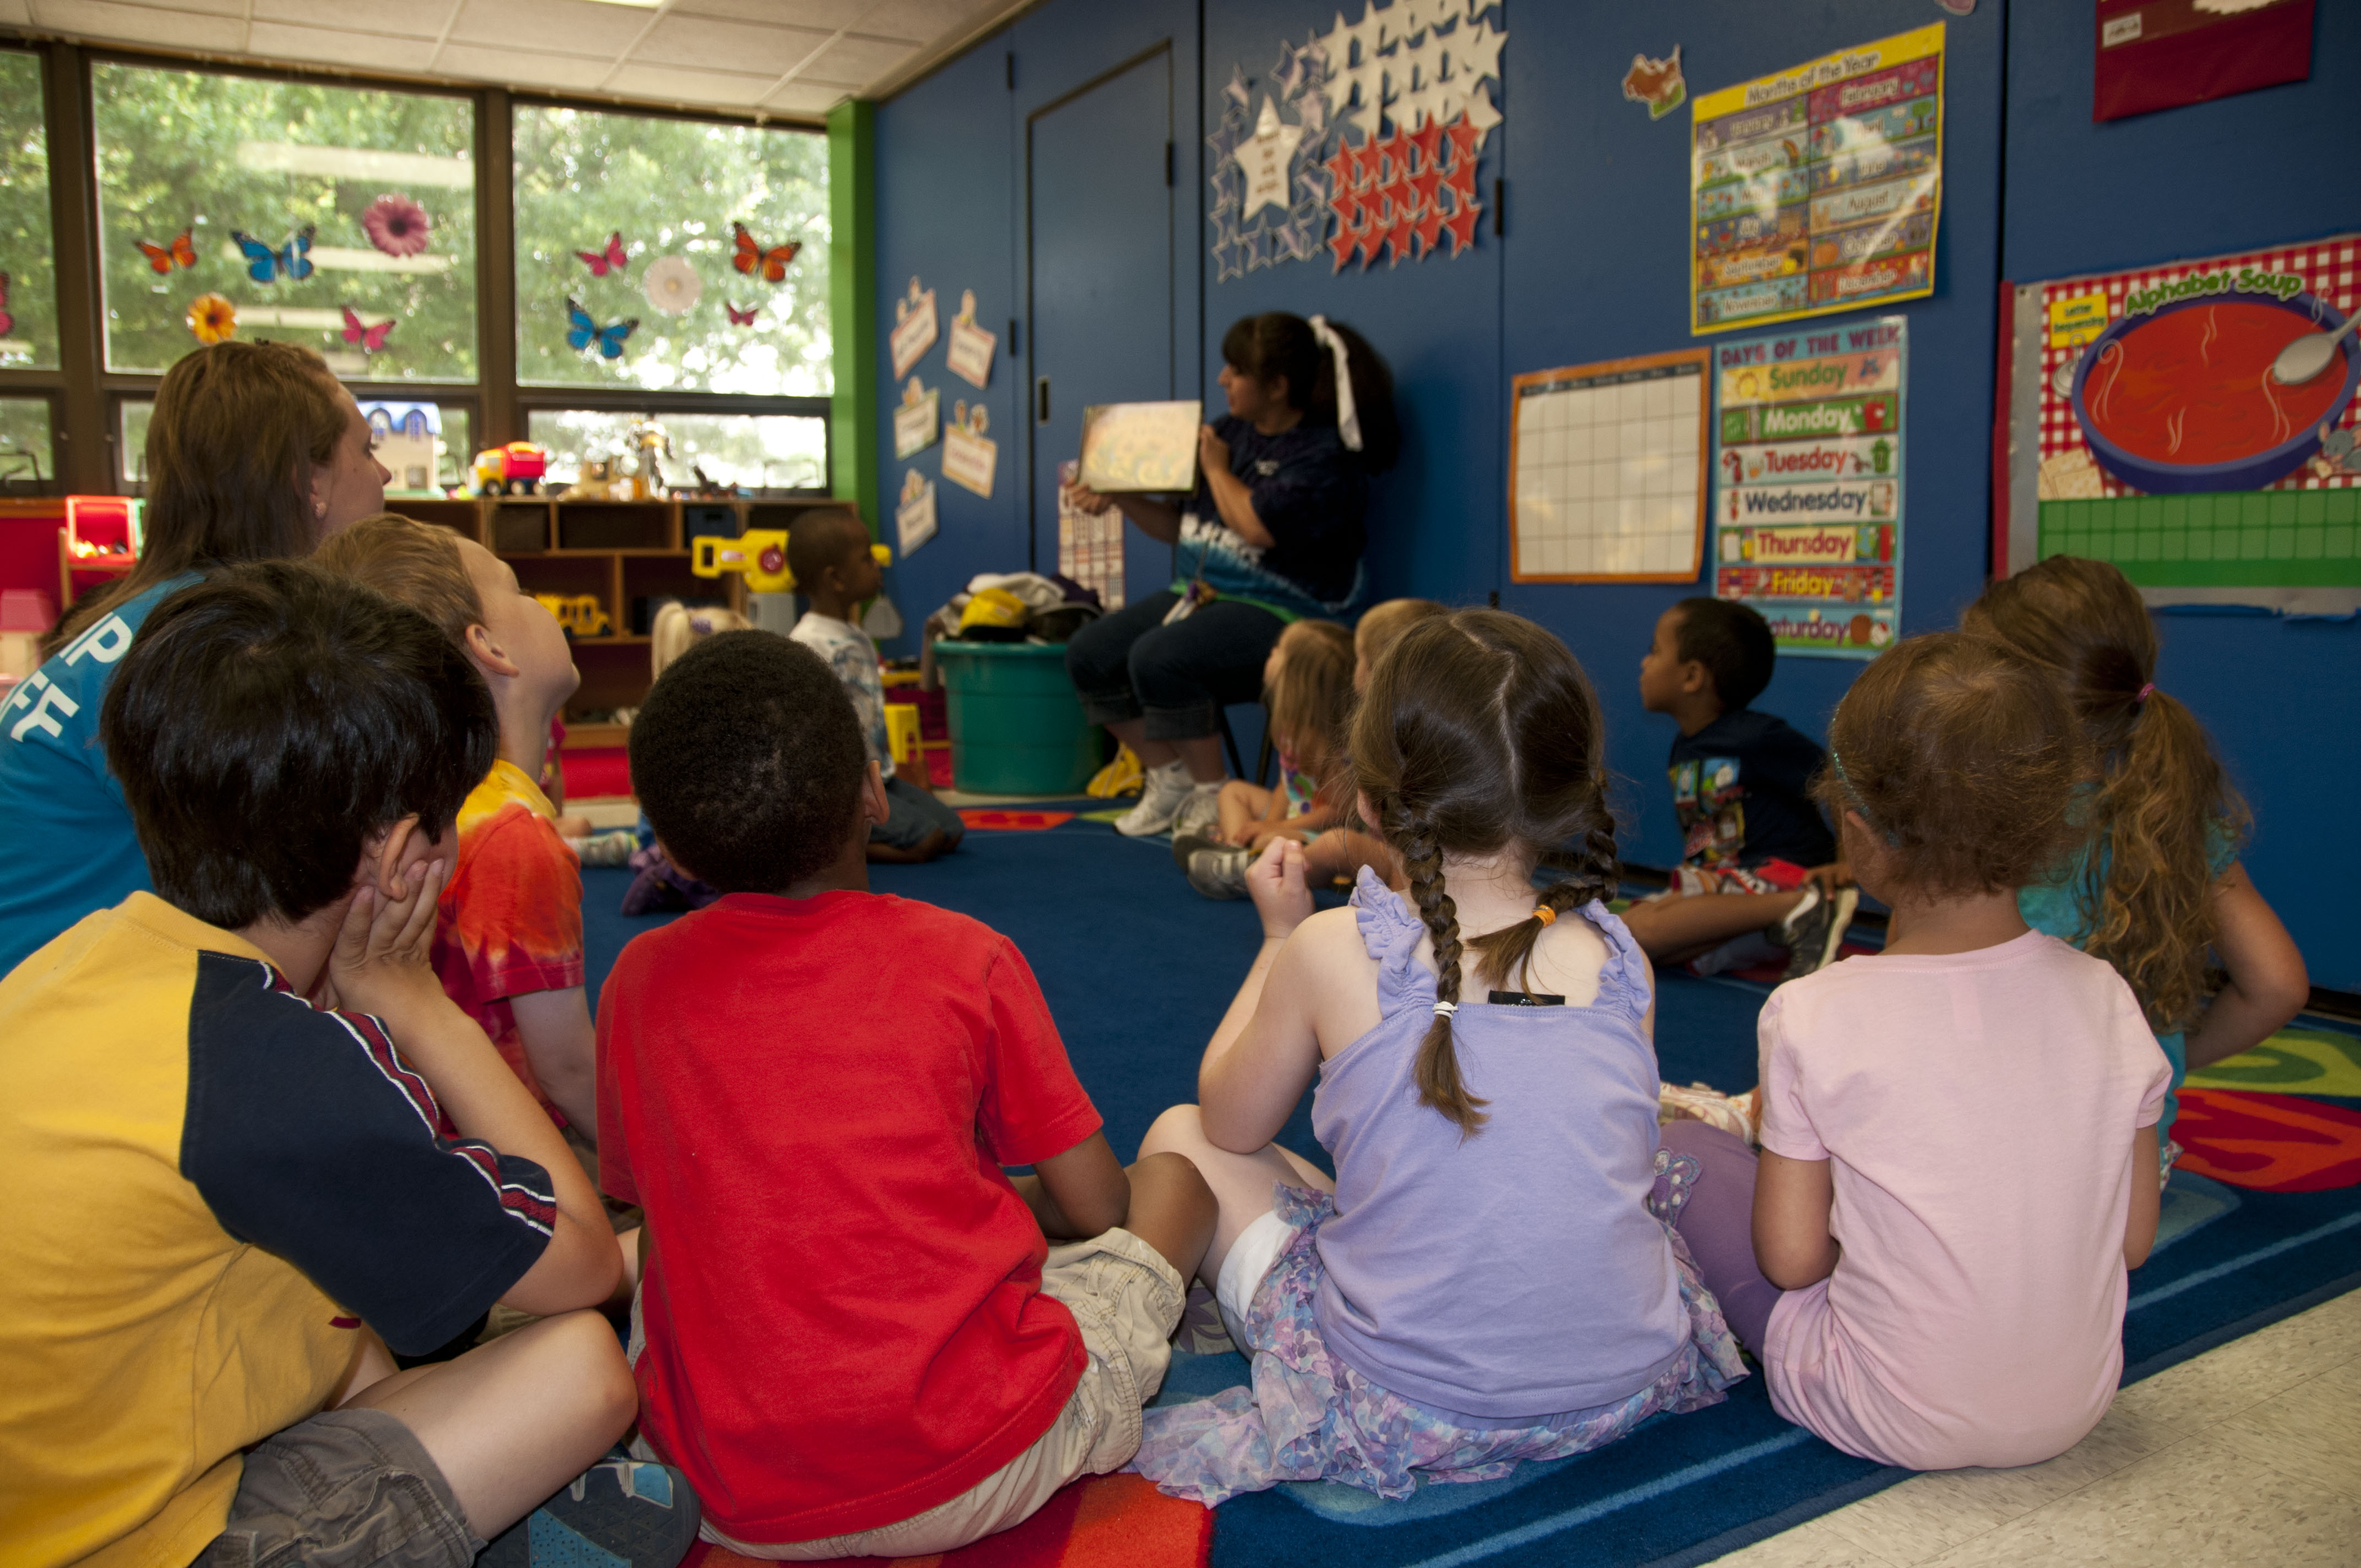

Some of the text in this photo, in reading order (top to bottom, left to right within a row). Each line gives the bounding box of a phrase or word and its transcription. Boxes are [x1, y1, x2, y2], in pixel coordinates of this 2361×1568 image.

[1748, 53, 1879, 102] Months of the Year
[1843, 80, 1898, 104] February
[1848, 190, 1889, 214] August
[1845, 232, 1896, 254] Octber
[1726, 256, 1781, 276] September
[1840, 270, 1897, 292] December
[2126, 268, 2303, 315] Alphabet Soup
[1725, 294, 1776, 313] November
[1722, 326, 1899, 366] DAYS OF THE WEEK
[1770, 360, 1847, 390] Sunday
[1765, 403, 1851, 435] Monday
[1765, 446, 1847, 475] Tuesday
[1745, 488, 1867, 515] Wednesday
[1758, 529, 1851, 559] Thursday
[1772, 569, 1836, 601] Friday
[1762, 613, 1851, 645] aturday
